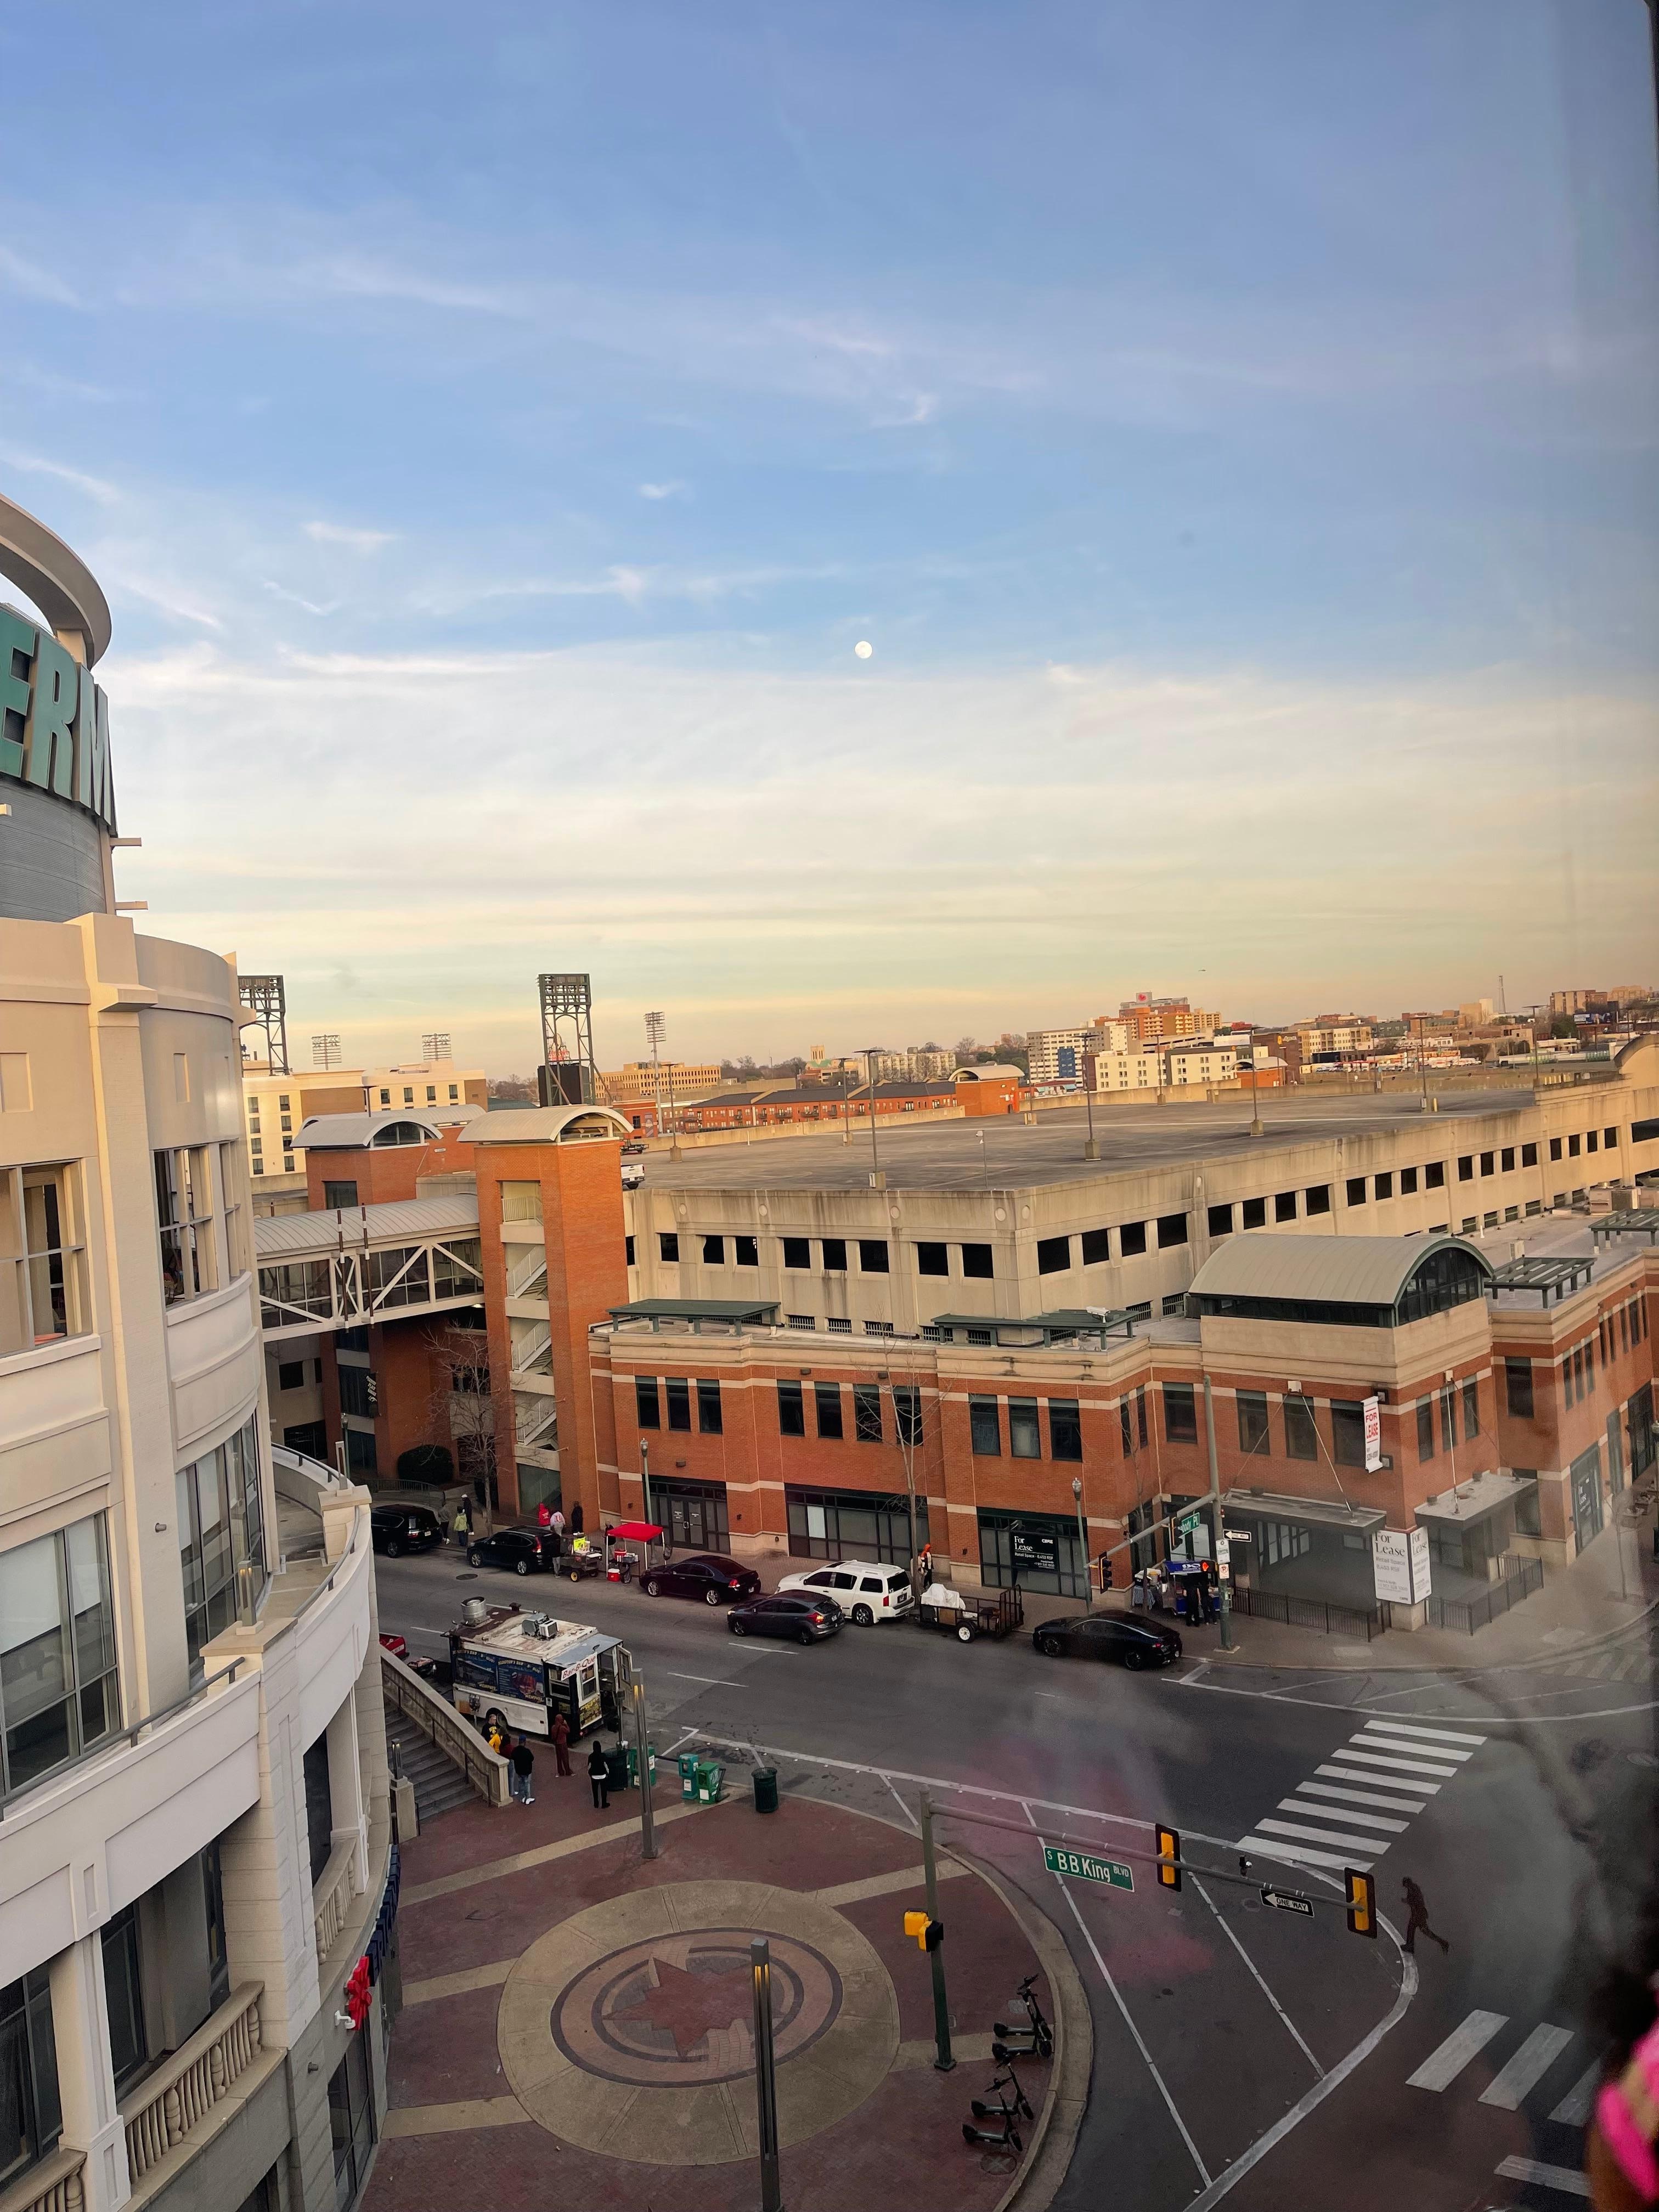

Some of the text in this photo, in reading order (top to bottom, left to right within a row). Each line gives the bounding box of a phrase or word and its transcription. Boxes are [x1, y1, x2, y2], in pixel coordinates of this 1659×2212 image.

[1365, 1413, 1378, 1423] FOR
[1366, 1423, 1379, 1438] LEASE
[1014, 1536, 1025, 1544] For
[1374, 1531, 1392, 1543] For
[1412, 1533, 1421, 1544] For
[1014, 1543, 1033, 1551] Lease
[1375, 1542, 1406, 1557] Lease
[1412, 1541, 1427, 1556] Lease
[562, 1656, 596, 1679] Bar-B-Que
[1047, 1850, 1053, 1860] S
[1113, 1865, 1130, 1877] BLVD
[1276, 1898, 1307, 1910] ONE WAY
